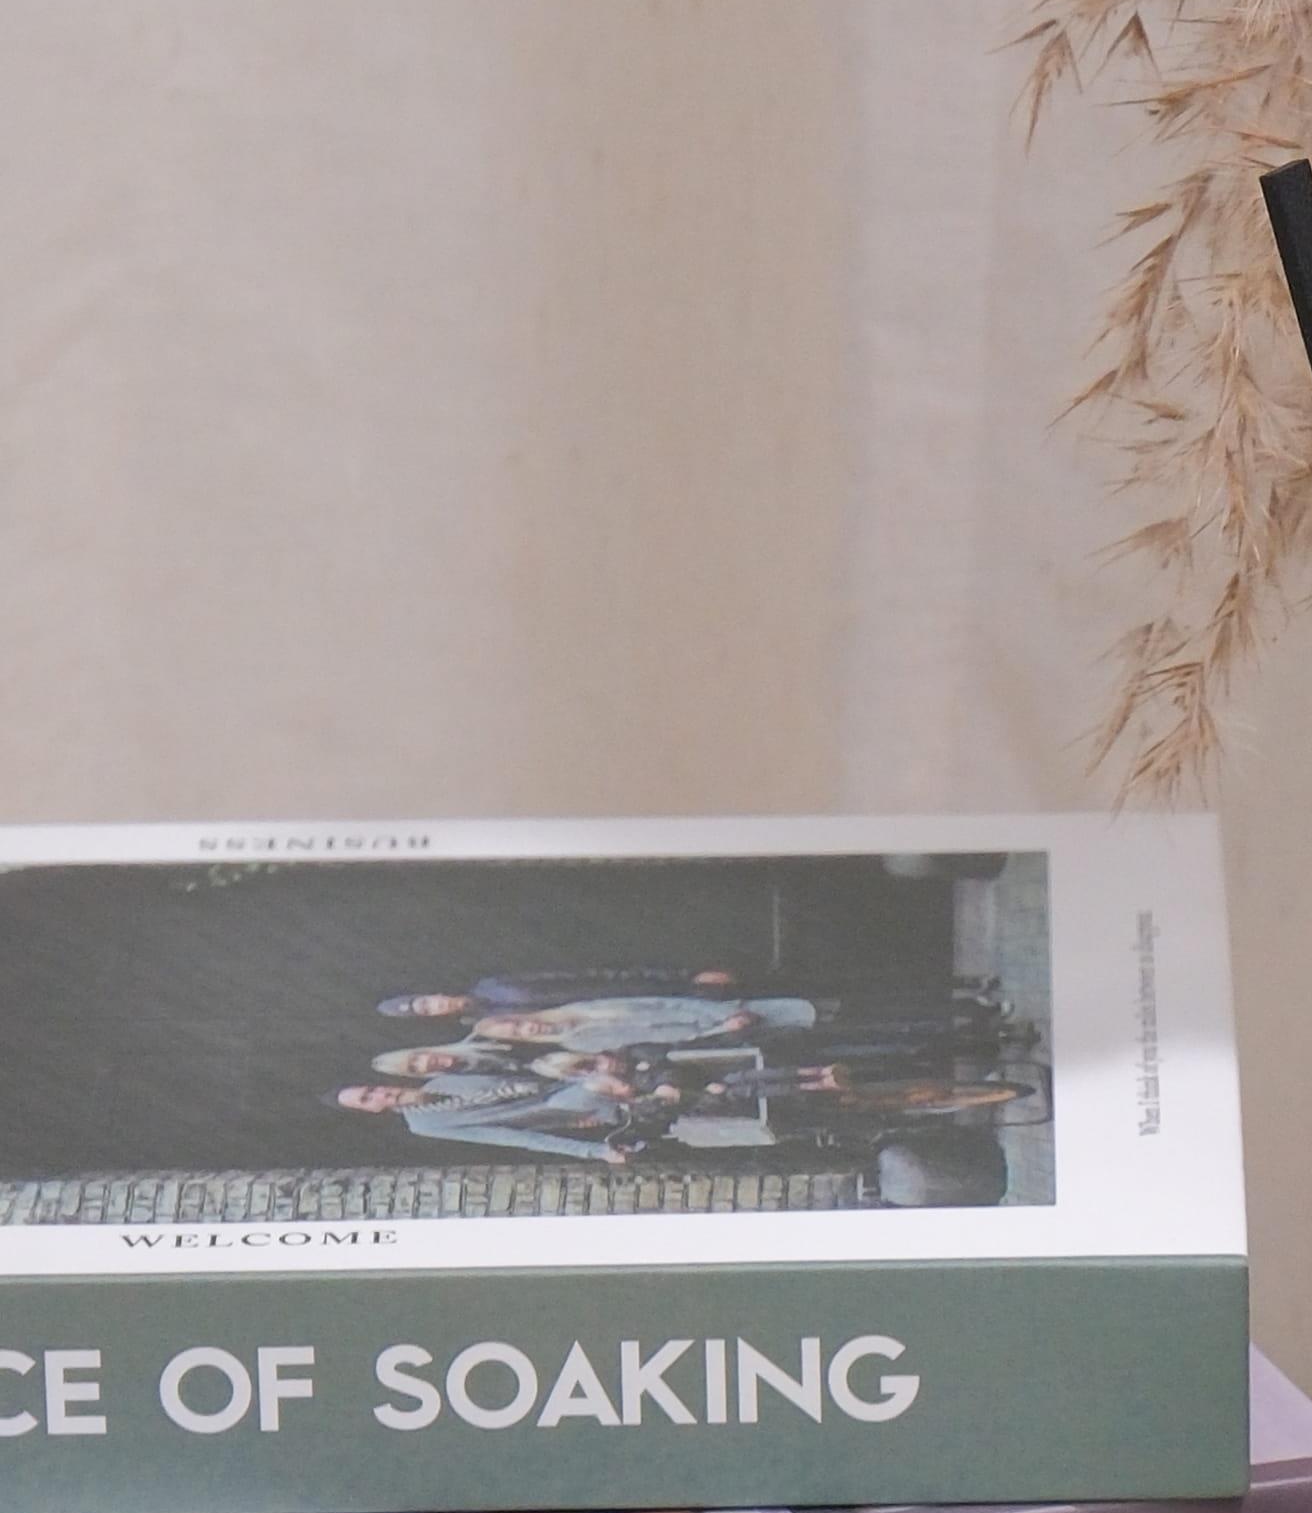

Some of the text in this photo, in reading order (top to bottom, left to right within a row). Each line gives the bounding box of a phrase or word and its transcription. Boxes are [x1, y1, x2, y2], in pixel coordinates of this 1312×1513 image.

[120, 1230, 398, 1249] WELCOME
[159, 1345, 315, 1434] OF
[373, 1335, 920, 1431] SOAKING
